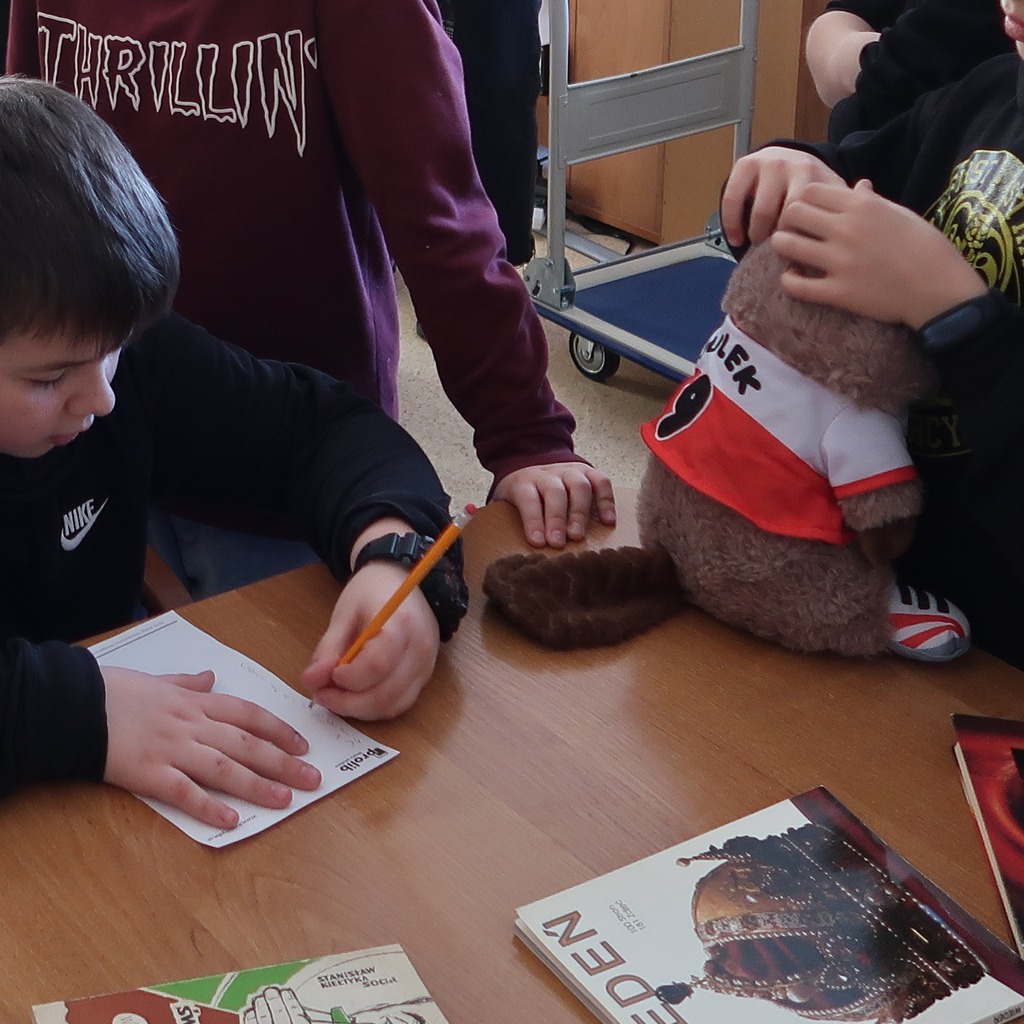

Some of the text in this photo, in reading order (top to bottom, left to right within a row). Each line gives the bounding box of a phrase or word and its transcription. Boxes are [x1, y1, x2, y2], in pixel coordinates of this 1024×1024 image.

[62, 498, 95, 536] NIKE
[339, 747, 376, 772] prolib
[317, 966, 376, 983] STANISŁAW
